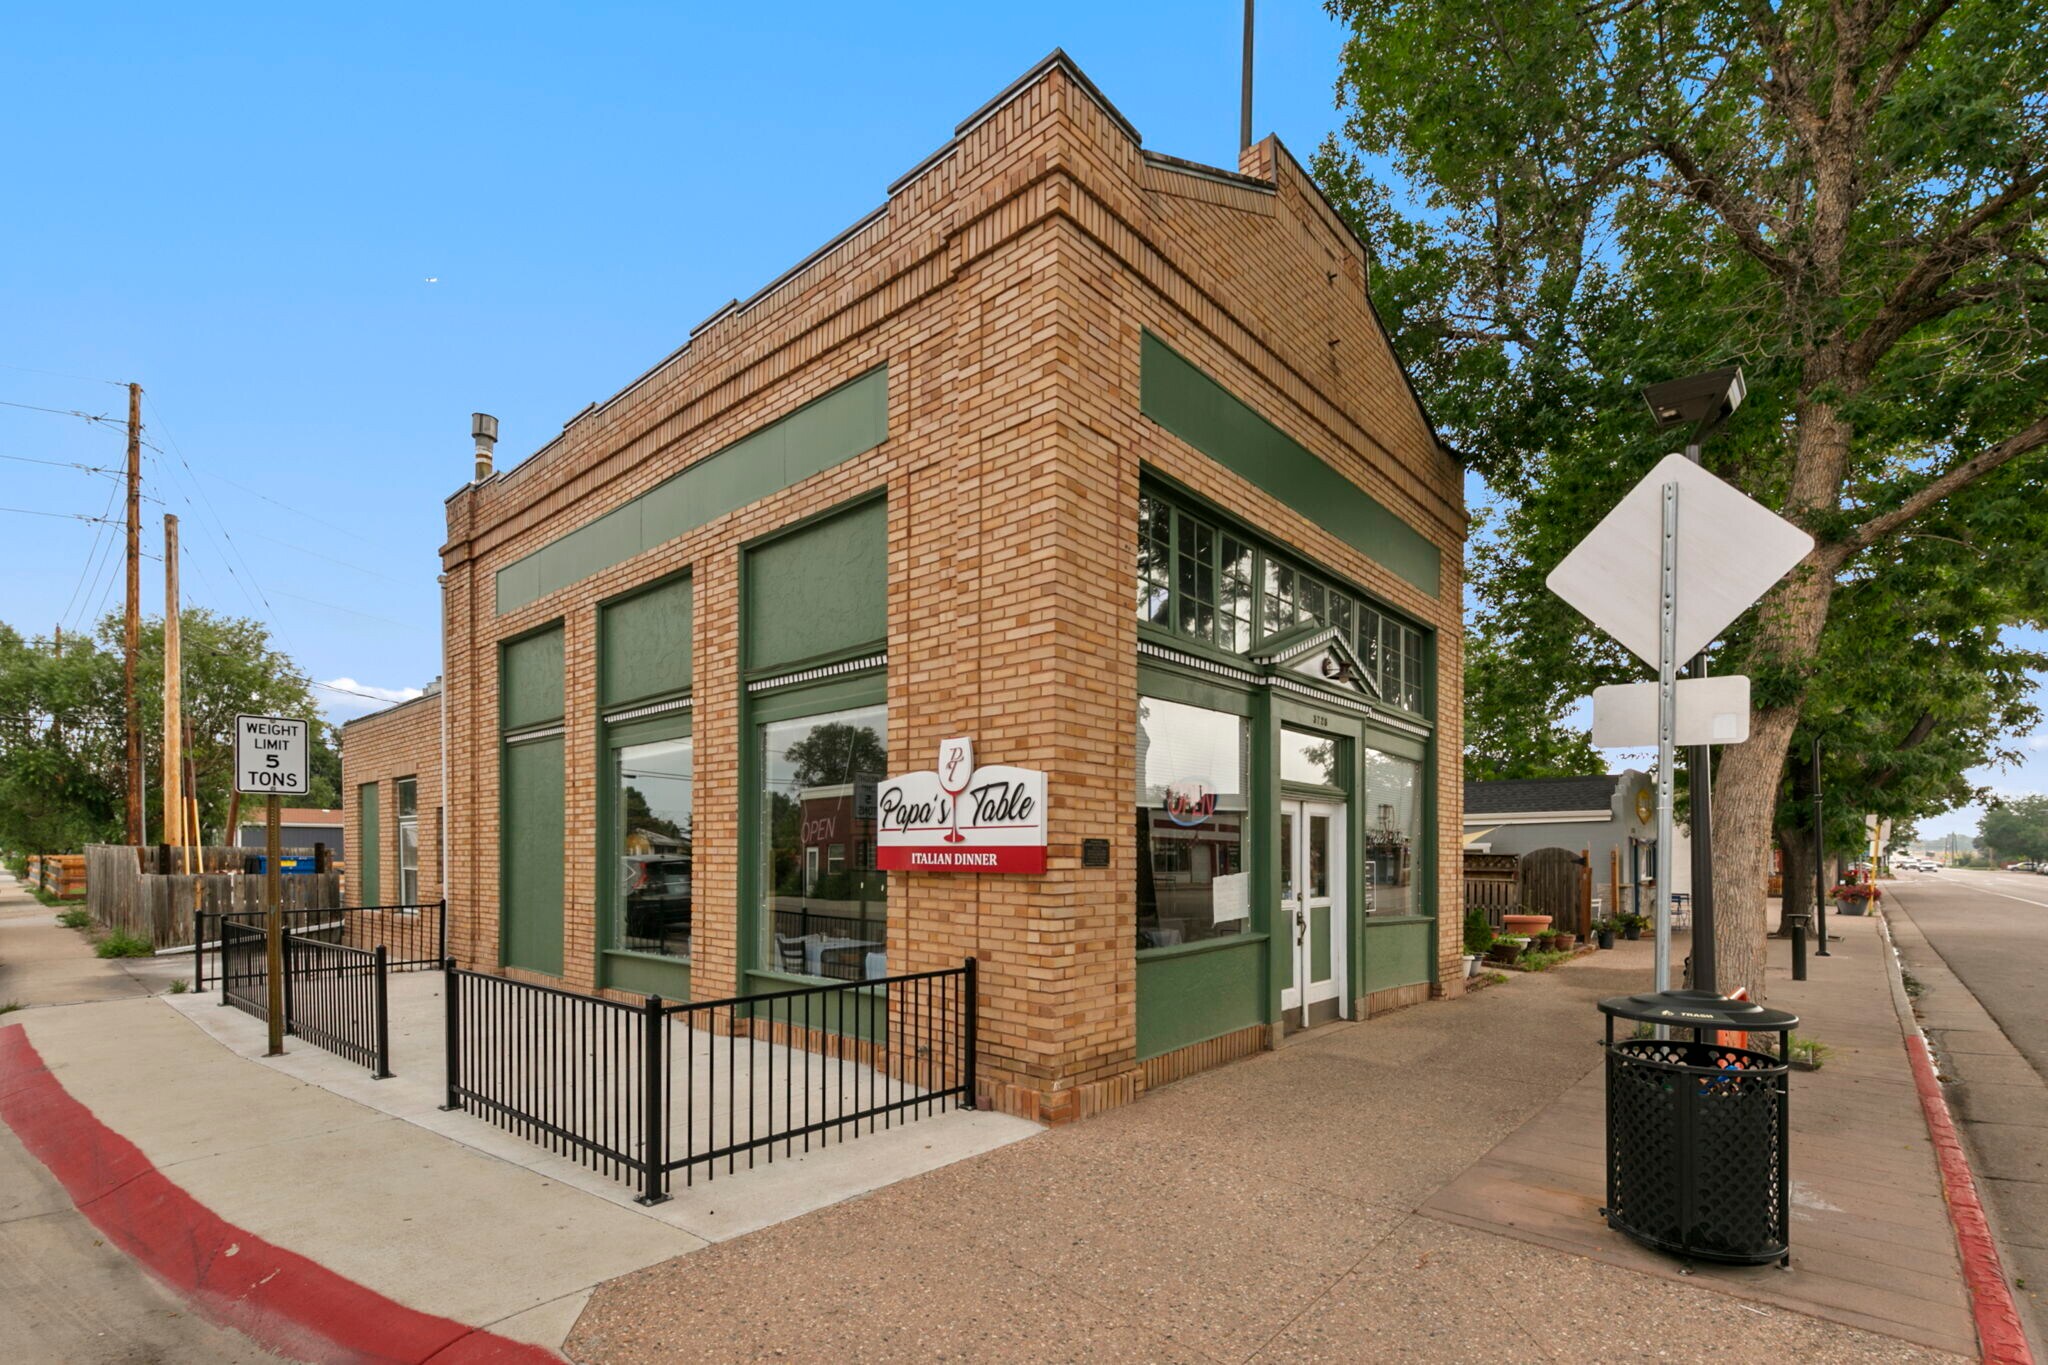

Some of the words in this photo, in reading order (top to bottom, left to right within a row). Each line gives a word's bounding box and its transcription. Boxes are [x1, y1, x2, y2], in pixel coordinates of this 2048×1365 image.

[246, 722, 298, 736] WEIGHT
[254, 738, 289, 750] LIMIT
[266, 754, 280, 768] 5
[248, 771, 298, 787] TONS
[880, 786, 951, 834] Papa's
[970, 781, 1035, 827] Table
[801, 816, 836, 843] OPEN
[911, 852, 954, 865] ITALIAN
[954, 852, 998, 866] DINNER
